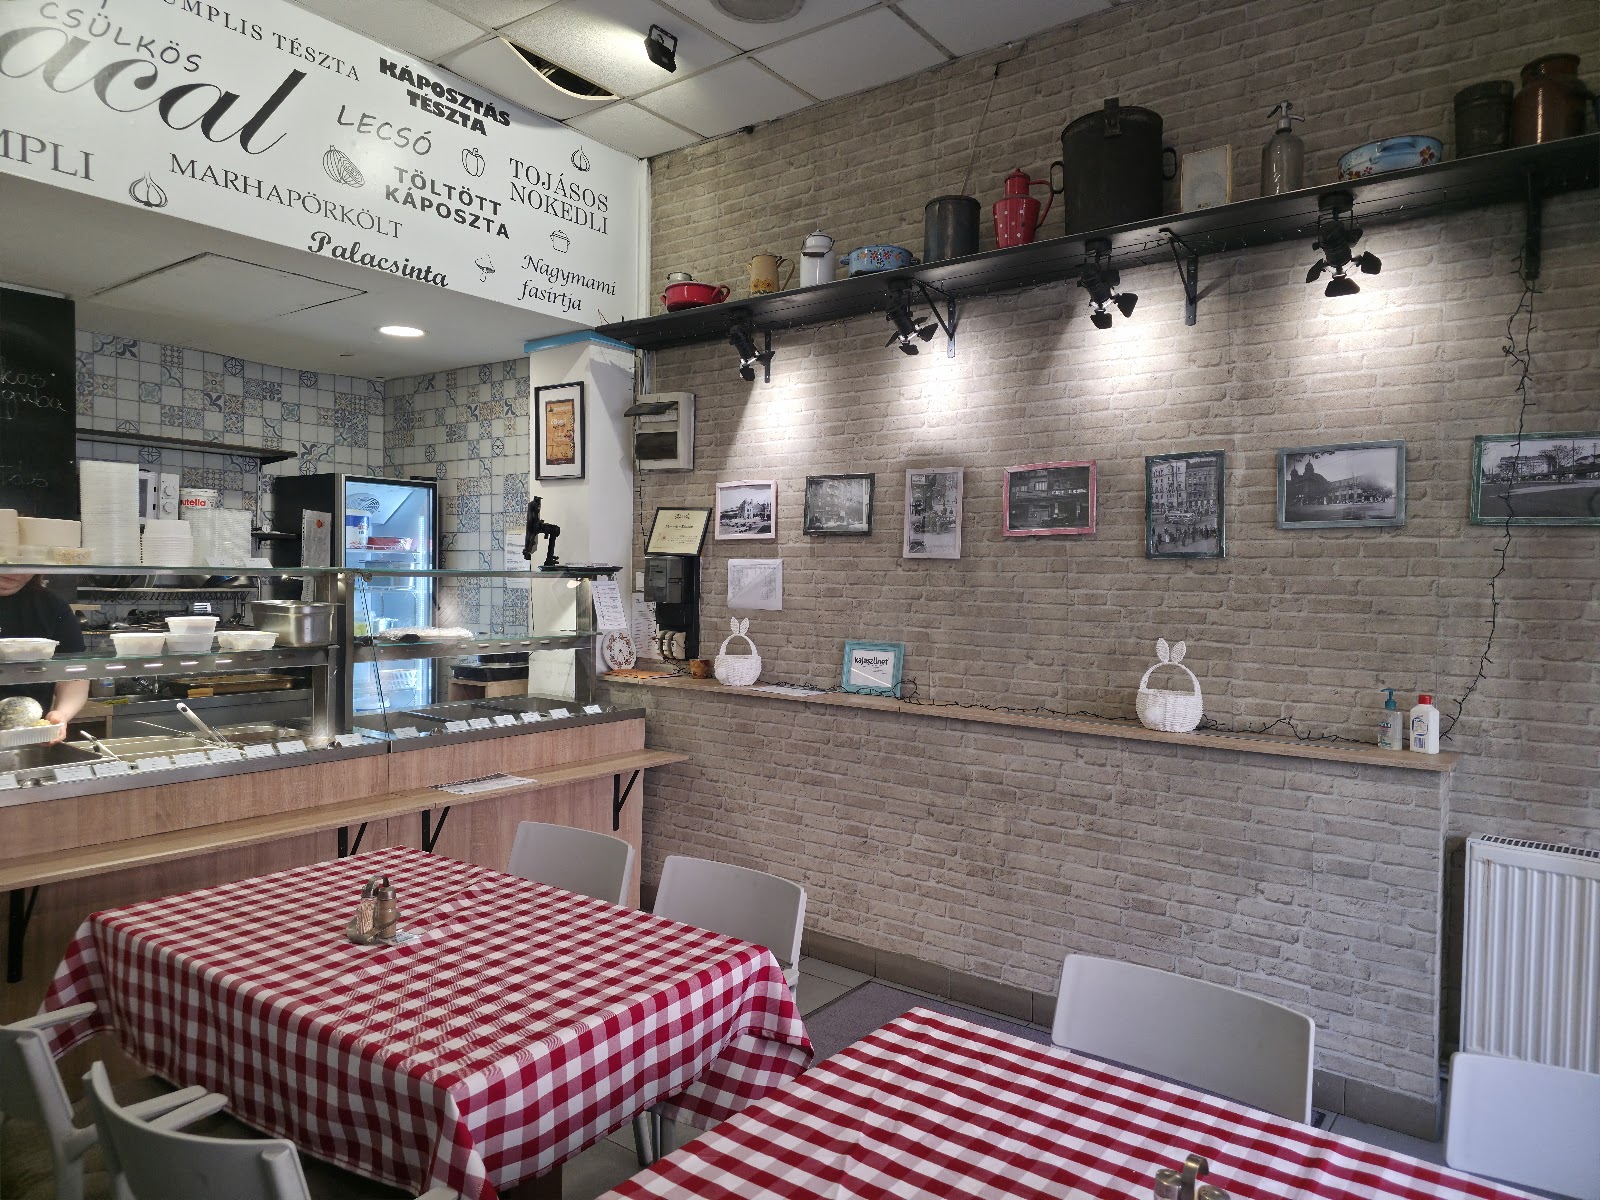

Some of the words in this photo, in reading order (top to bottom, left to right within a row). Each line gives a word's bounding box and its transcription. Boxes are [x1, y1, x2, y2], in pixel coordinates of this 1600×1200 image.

[39, 2, 202, 72] CSÜLKÖS
[163, 0, 263, 41] MPLIS
[272, 32, 360, 81] TÉSZTA
[379, 57, 511, 127] KÁPOSZTÁS
[406, 88, 488, 136] TÉSZTA
[336, 104, 432, 156] LECSÓ
[169, 152, 403, 239] MARHAPÖRKÖLT
[385, 184, 510, 239] KÁPOSZTA
[393, 165, 502, 217] TÖLTÖTT
[509, 157, 609, 213] TOJÁSOS
[509, 181, 609, 235] NOKEDLI
[307, 230, 449, 288] Palacsinta
[520, 254, 617, 296] Nagymami
[516, 279, 583, 313] fasírtja
